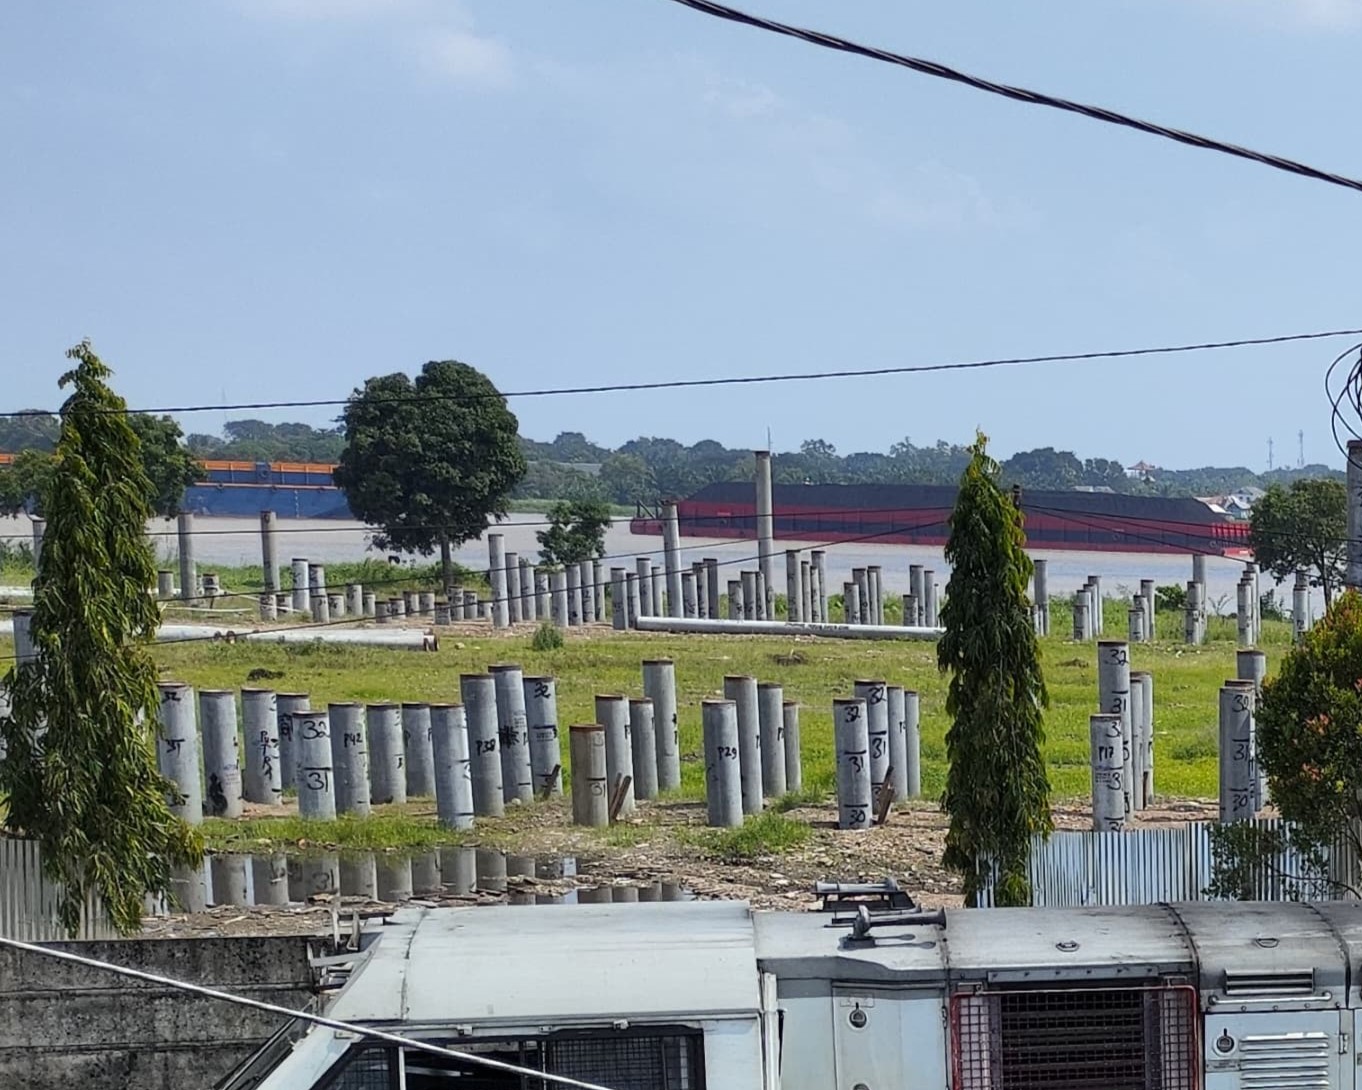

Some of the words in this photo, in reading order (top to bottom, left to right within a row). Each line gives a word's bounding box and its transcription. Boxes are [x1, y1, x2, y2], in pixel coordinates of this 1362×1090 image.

[303, 720, 330, 740] 32
[344, 732, 363, 748] P42
[872, 738, 886, 759] 31
[307, 771, 328, 792] 31
